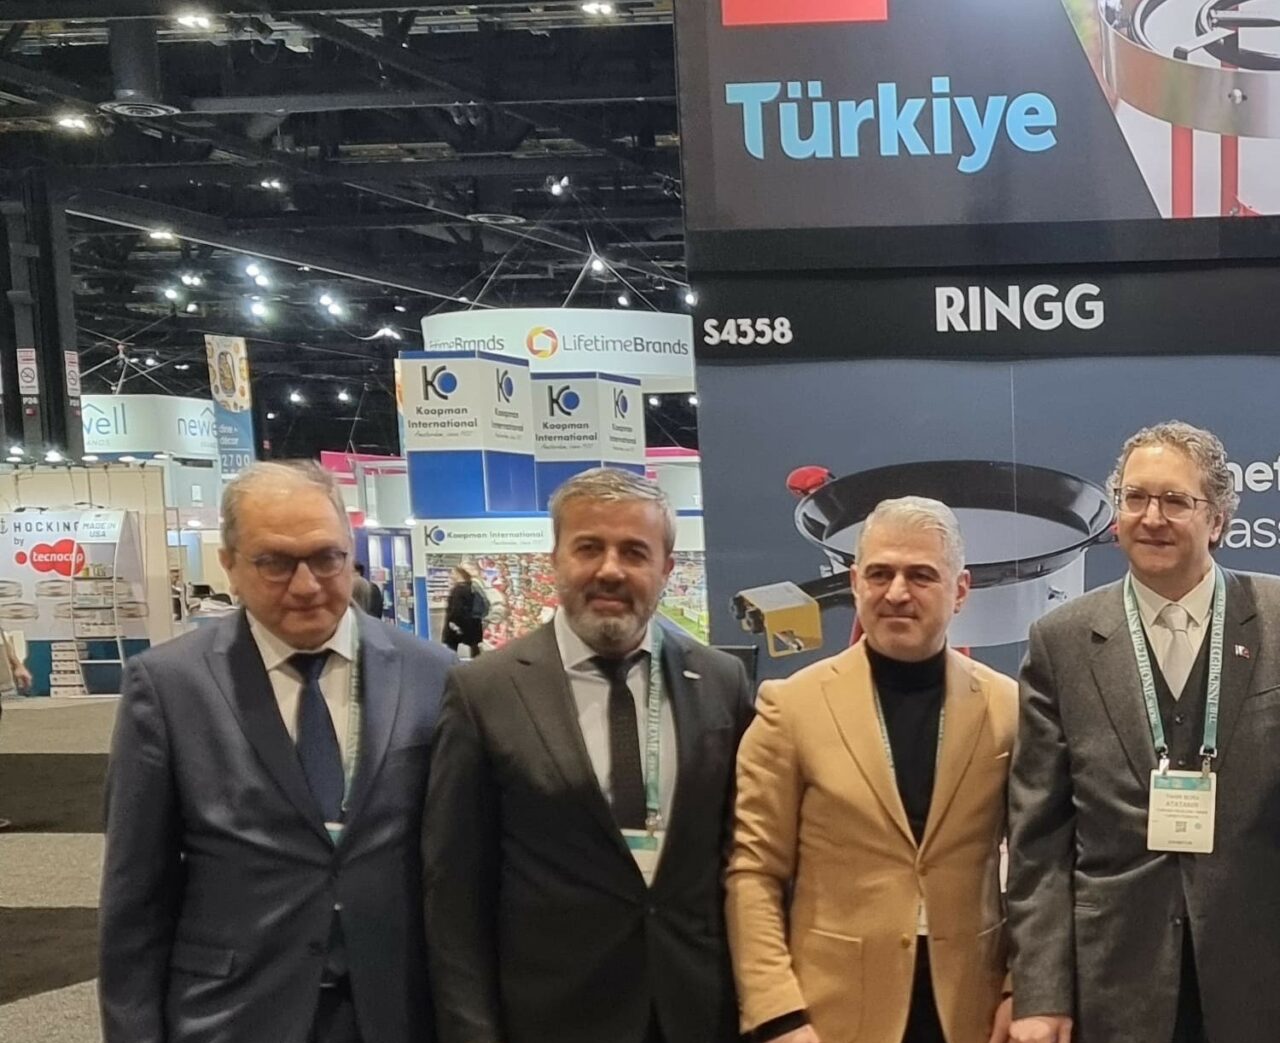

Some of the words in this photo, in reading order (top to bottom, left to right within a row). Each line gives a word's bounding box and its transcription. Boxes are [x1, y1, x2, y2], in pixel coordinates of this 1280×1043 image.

[726, 77, 1057, 173] Türkiye
[935, 284, 1104, 332] RINGG
[703, 317, 793, 345] S4358
[562, 335, 689, 355] LifetimeBrands
[416, 407, 468, 417] Koopman
[408, 418, 478, 429] International
[542, 422, 589, 432] Koopman
[535, 433, 598, 442] International
[13, 537, 24, 546] by
[32, 551, 84, 565] tecnocp
